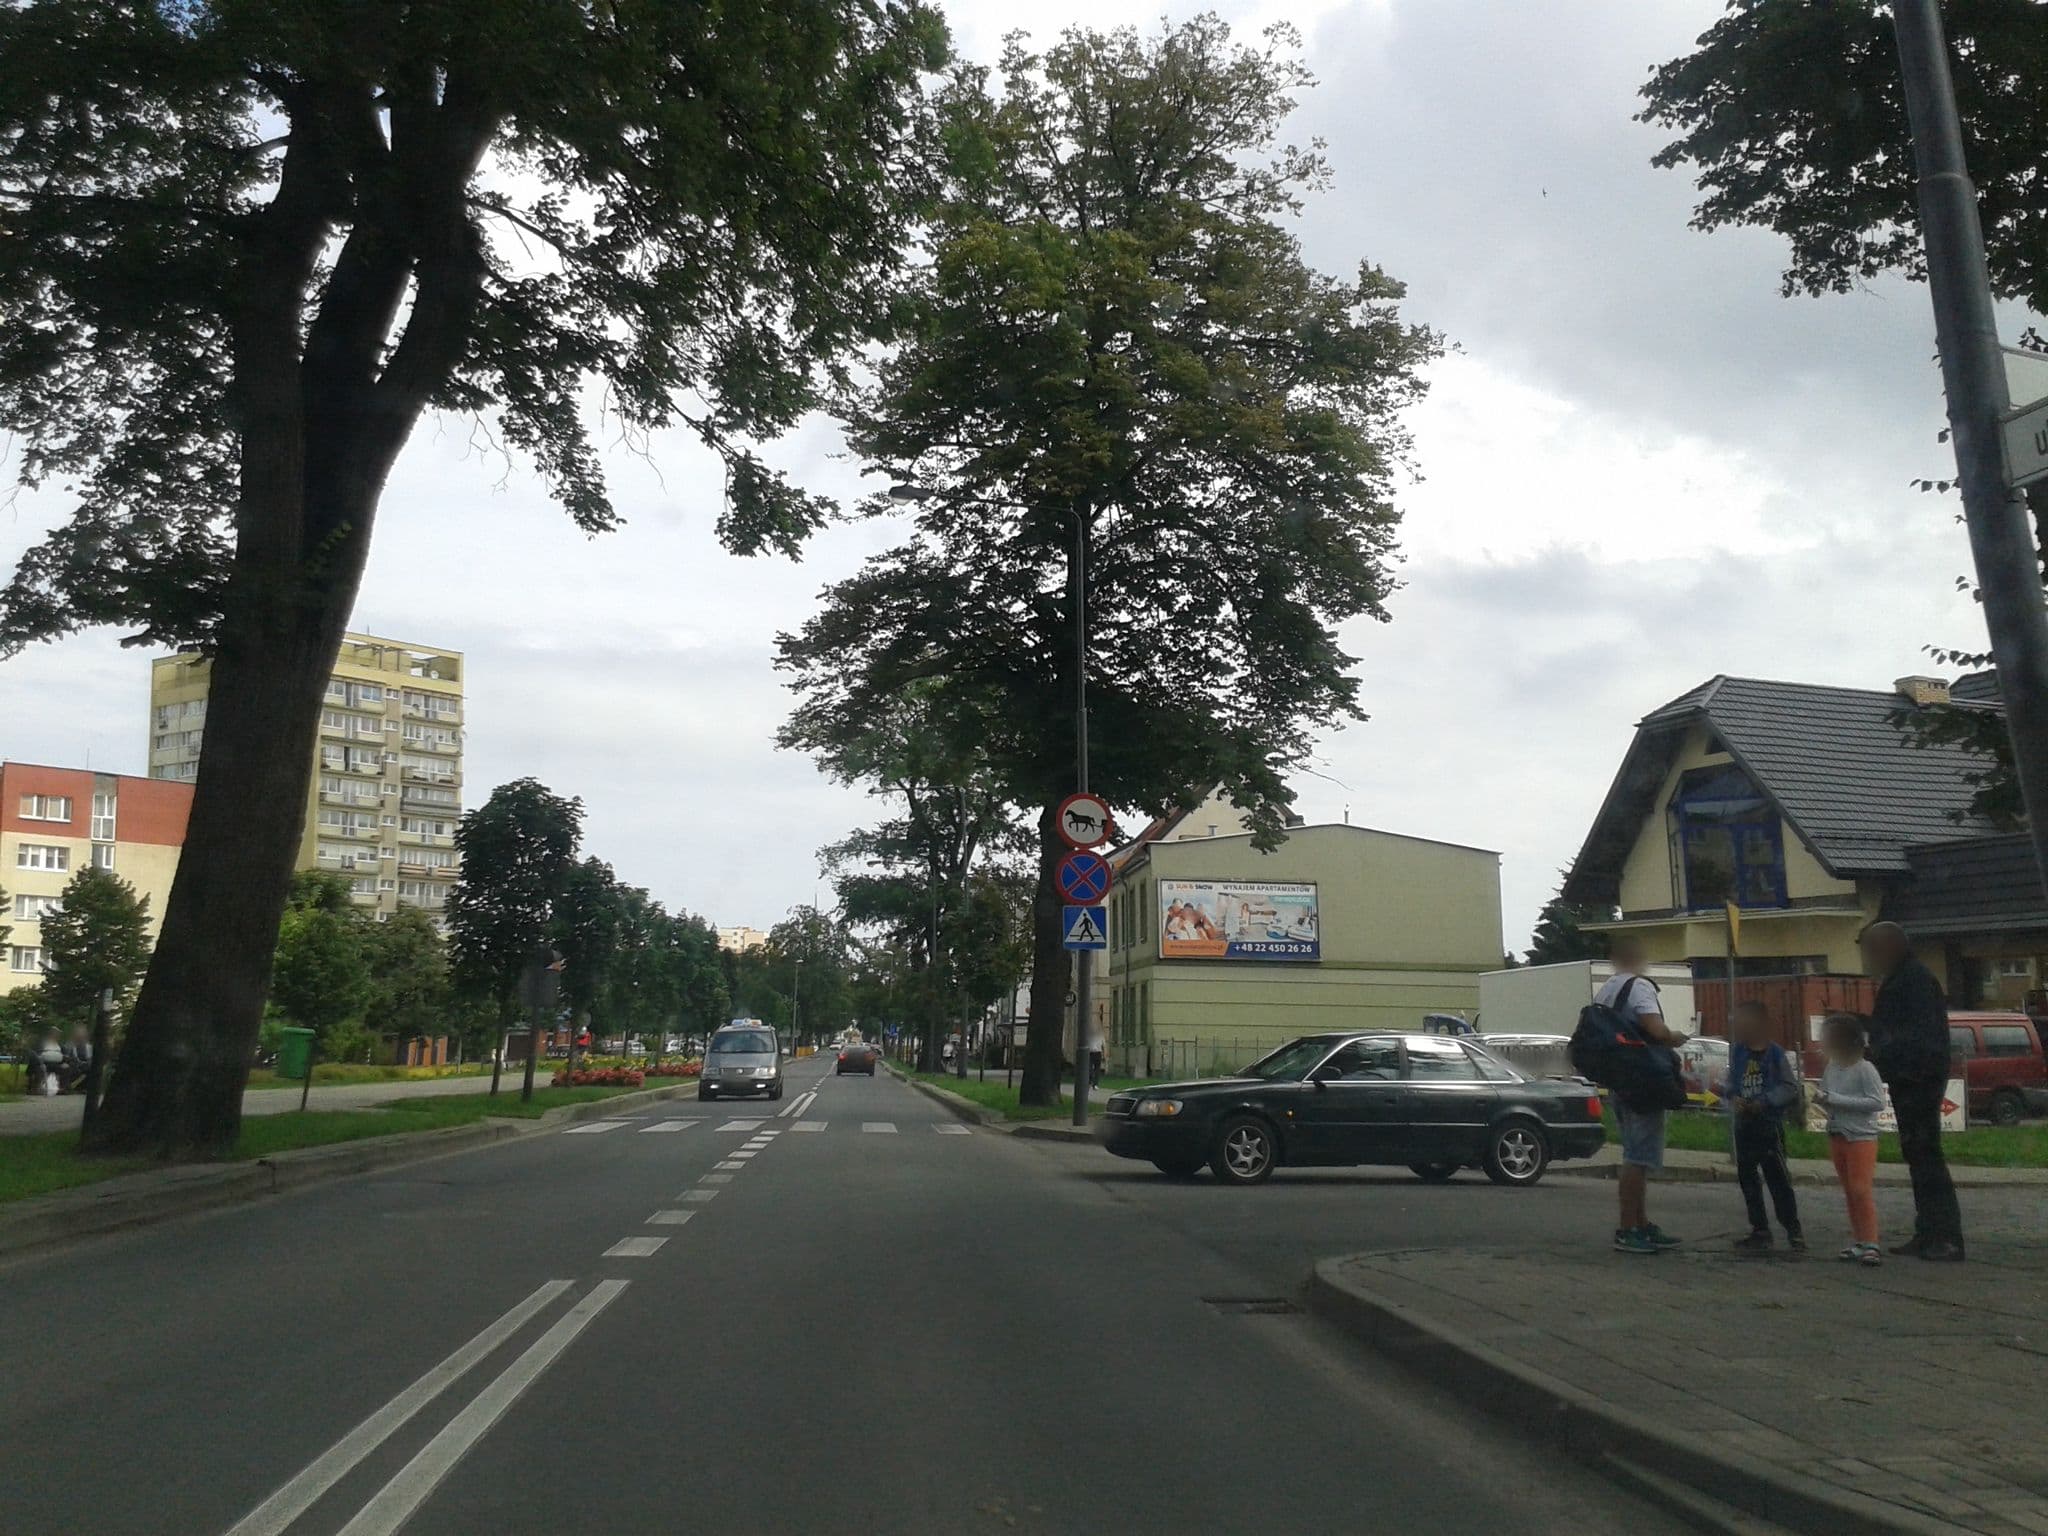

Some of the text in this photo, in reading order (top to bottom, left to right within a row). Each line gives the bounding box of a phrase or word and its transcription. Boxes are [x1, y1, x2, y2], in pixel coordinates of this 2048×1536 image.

[1222, 884, 1256, 892] WYNAJEM
[1233, 943, 1253, 952] +48
[1255, 943, 1266, 952] 22
[1268, 944, 1286, 953] 450
[1287, 944, 1299, 953] 26
[1300, 944, 1312, 953] 26
